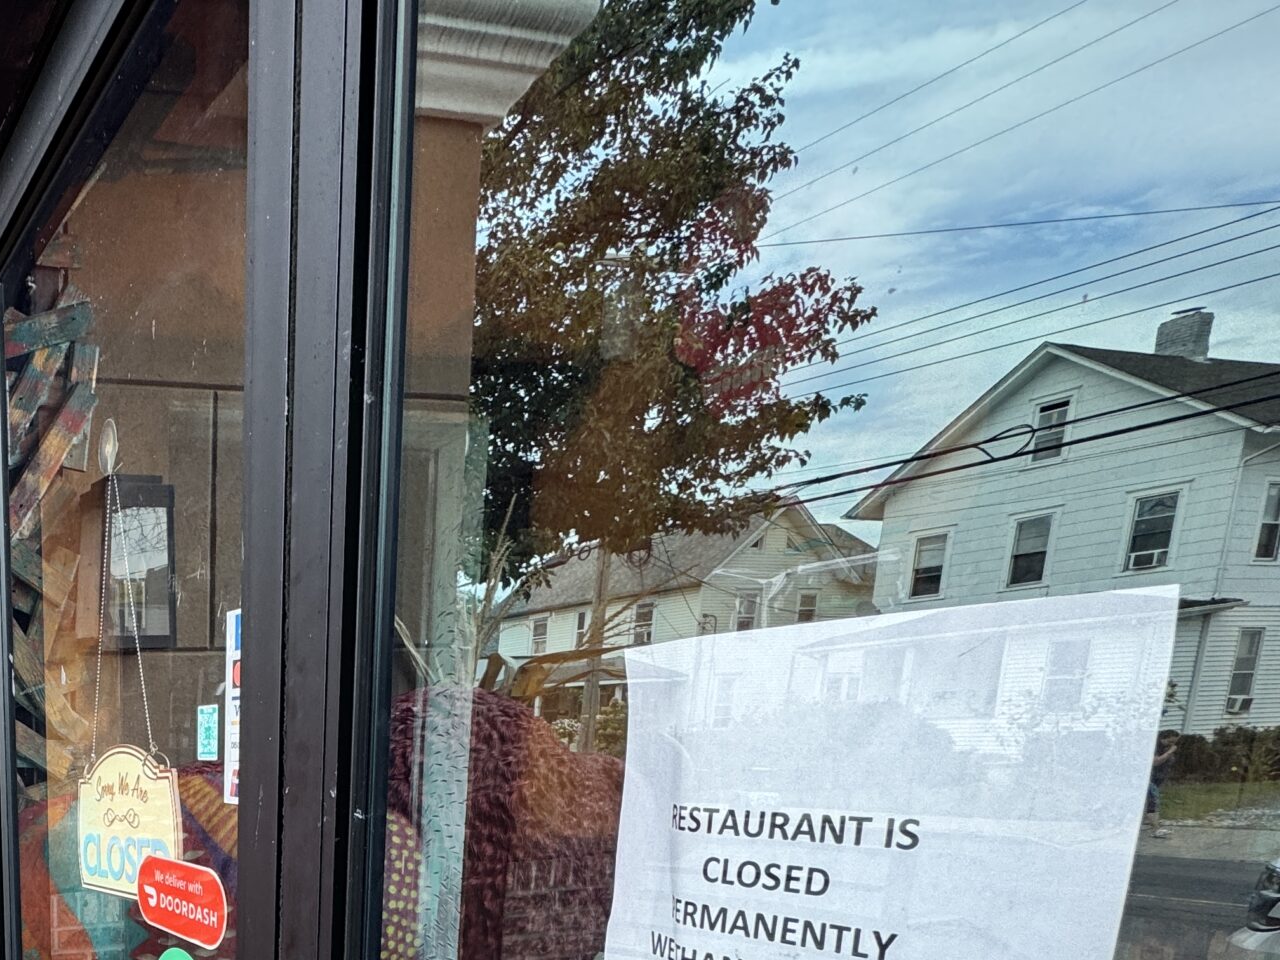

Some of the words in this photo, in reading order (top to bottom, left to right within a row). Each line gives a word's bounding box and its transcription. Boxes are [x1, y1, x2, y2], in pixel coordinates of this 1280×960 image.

[671, 803, 873, 847] RESTAURANT
[883, 817, 921, 851] IS
[154, 868, 164, 885] We
[165, 872, 187, 891] deliver
[188, 880, 203, 897] with
[701, 856, 831, 897] CLOSED
[160, 892, 218, 929] DOORDASH
